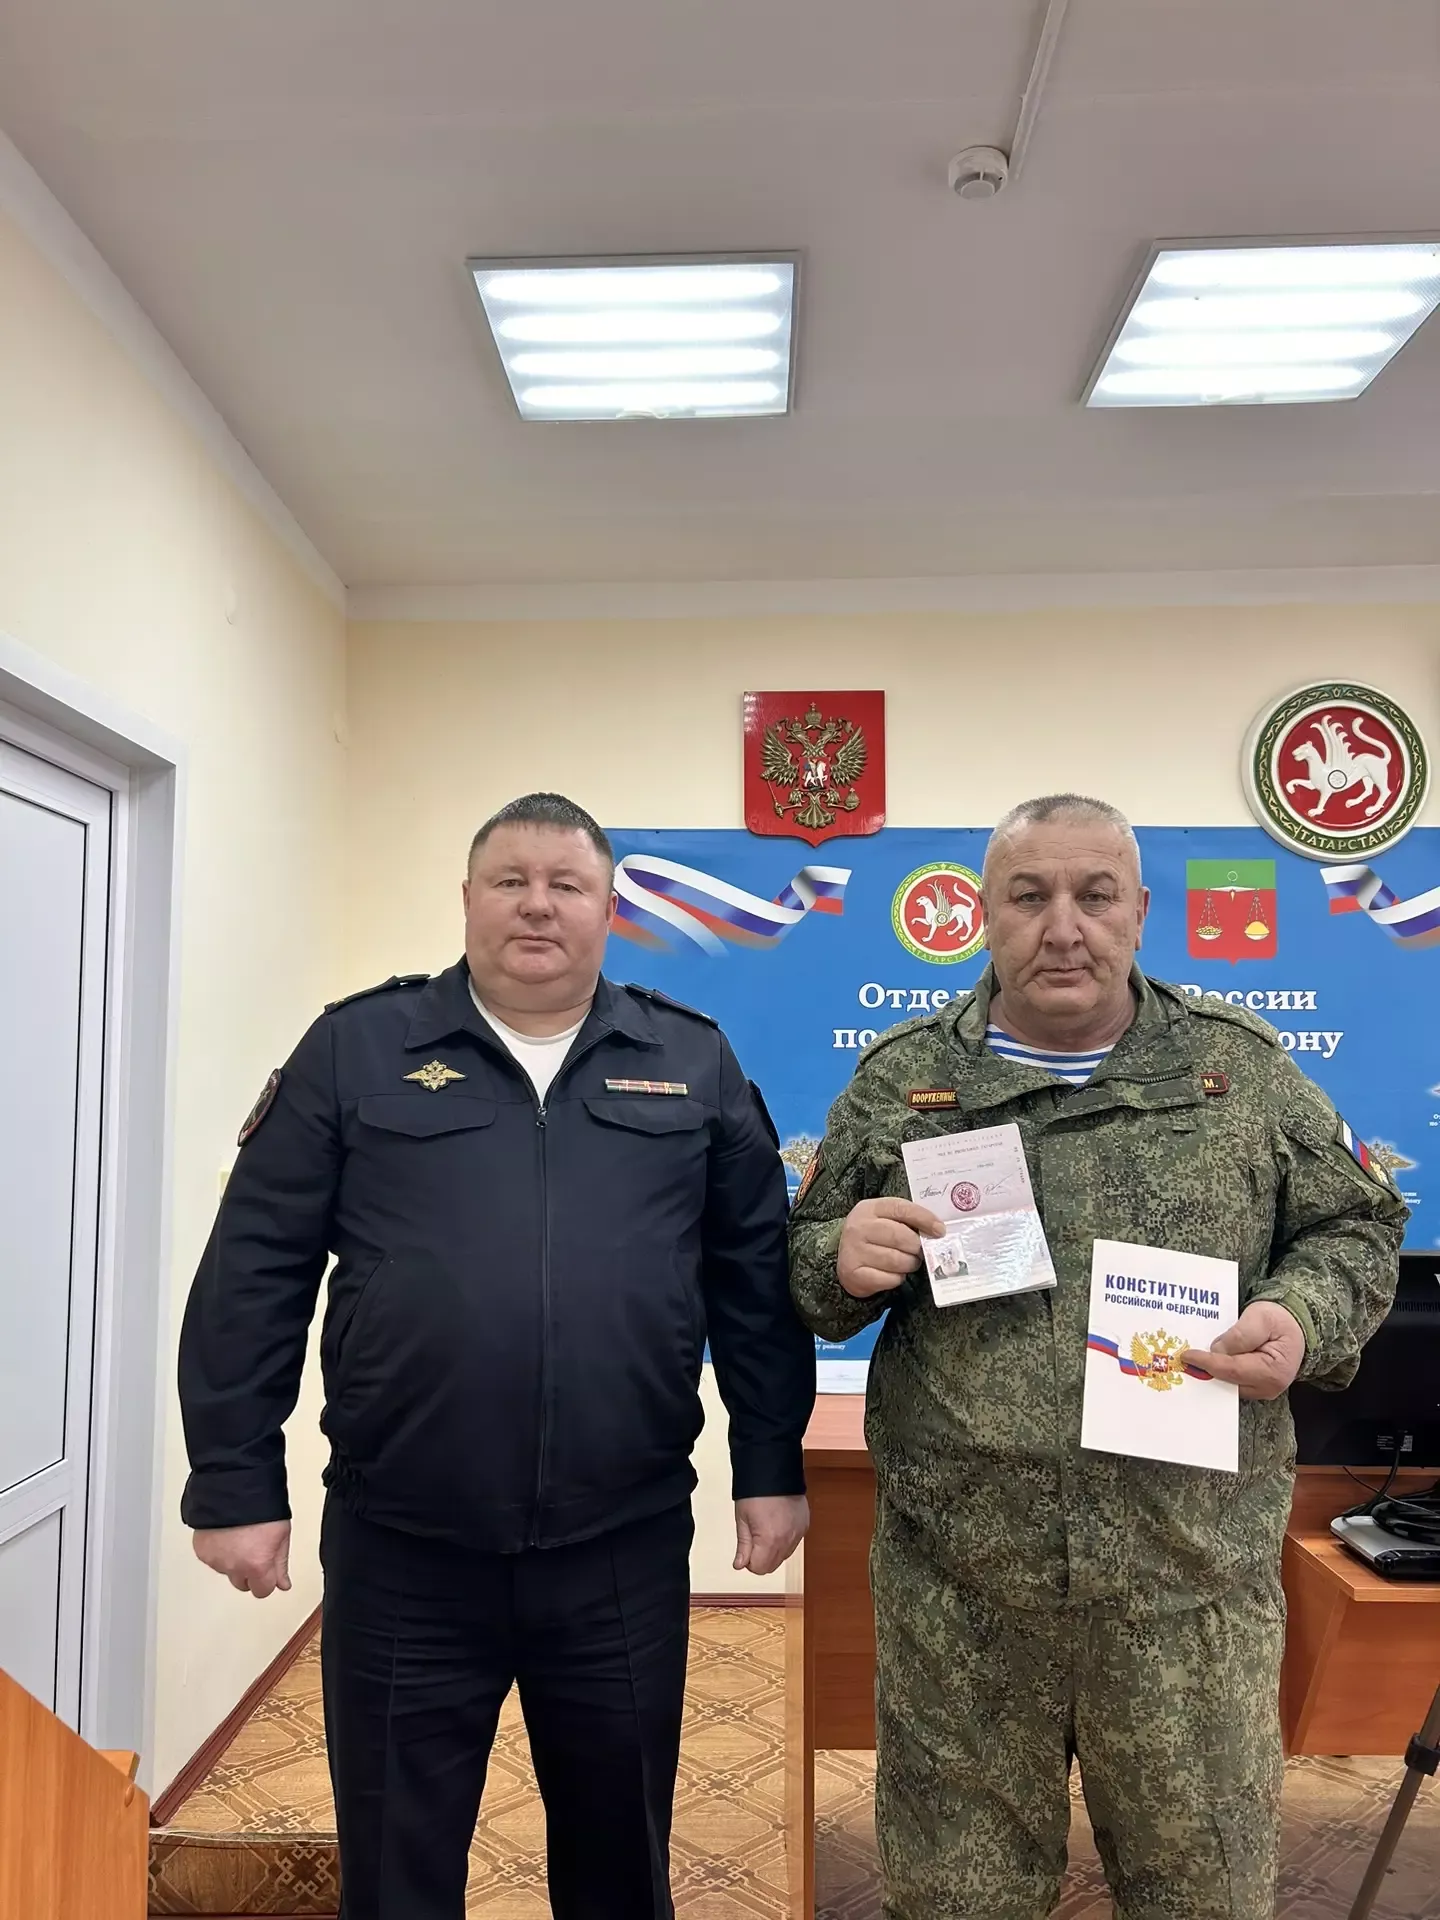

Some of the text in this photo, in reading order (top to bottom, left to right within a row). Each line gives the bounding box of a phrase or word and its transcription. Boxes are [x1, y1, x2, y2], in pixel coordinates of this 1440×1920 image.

[1301, 828, 1389, 850] ТАТАРСТАН
[916, 950, 971, 962] ТАТАРСТАН
[858, 982, 976, 1012] Отде
[832, 1029, 1344, 1059] по ону
[912, 1091, 956, 1103] ВООРУЖЕННЫЕ
[1105, 1274, 1220, 1306] КОНСТИТУЦИЯ
[1105, 1293, 1220, 1320] РОССИЙСКОЙ ФЕДЕРАЦИИ
